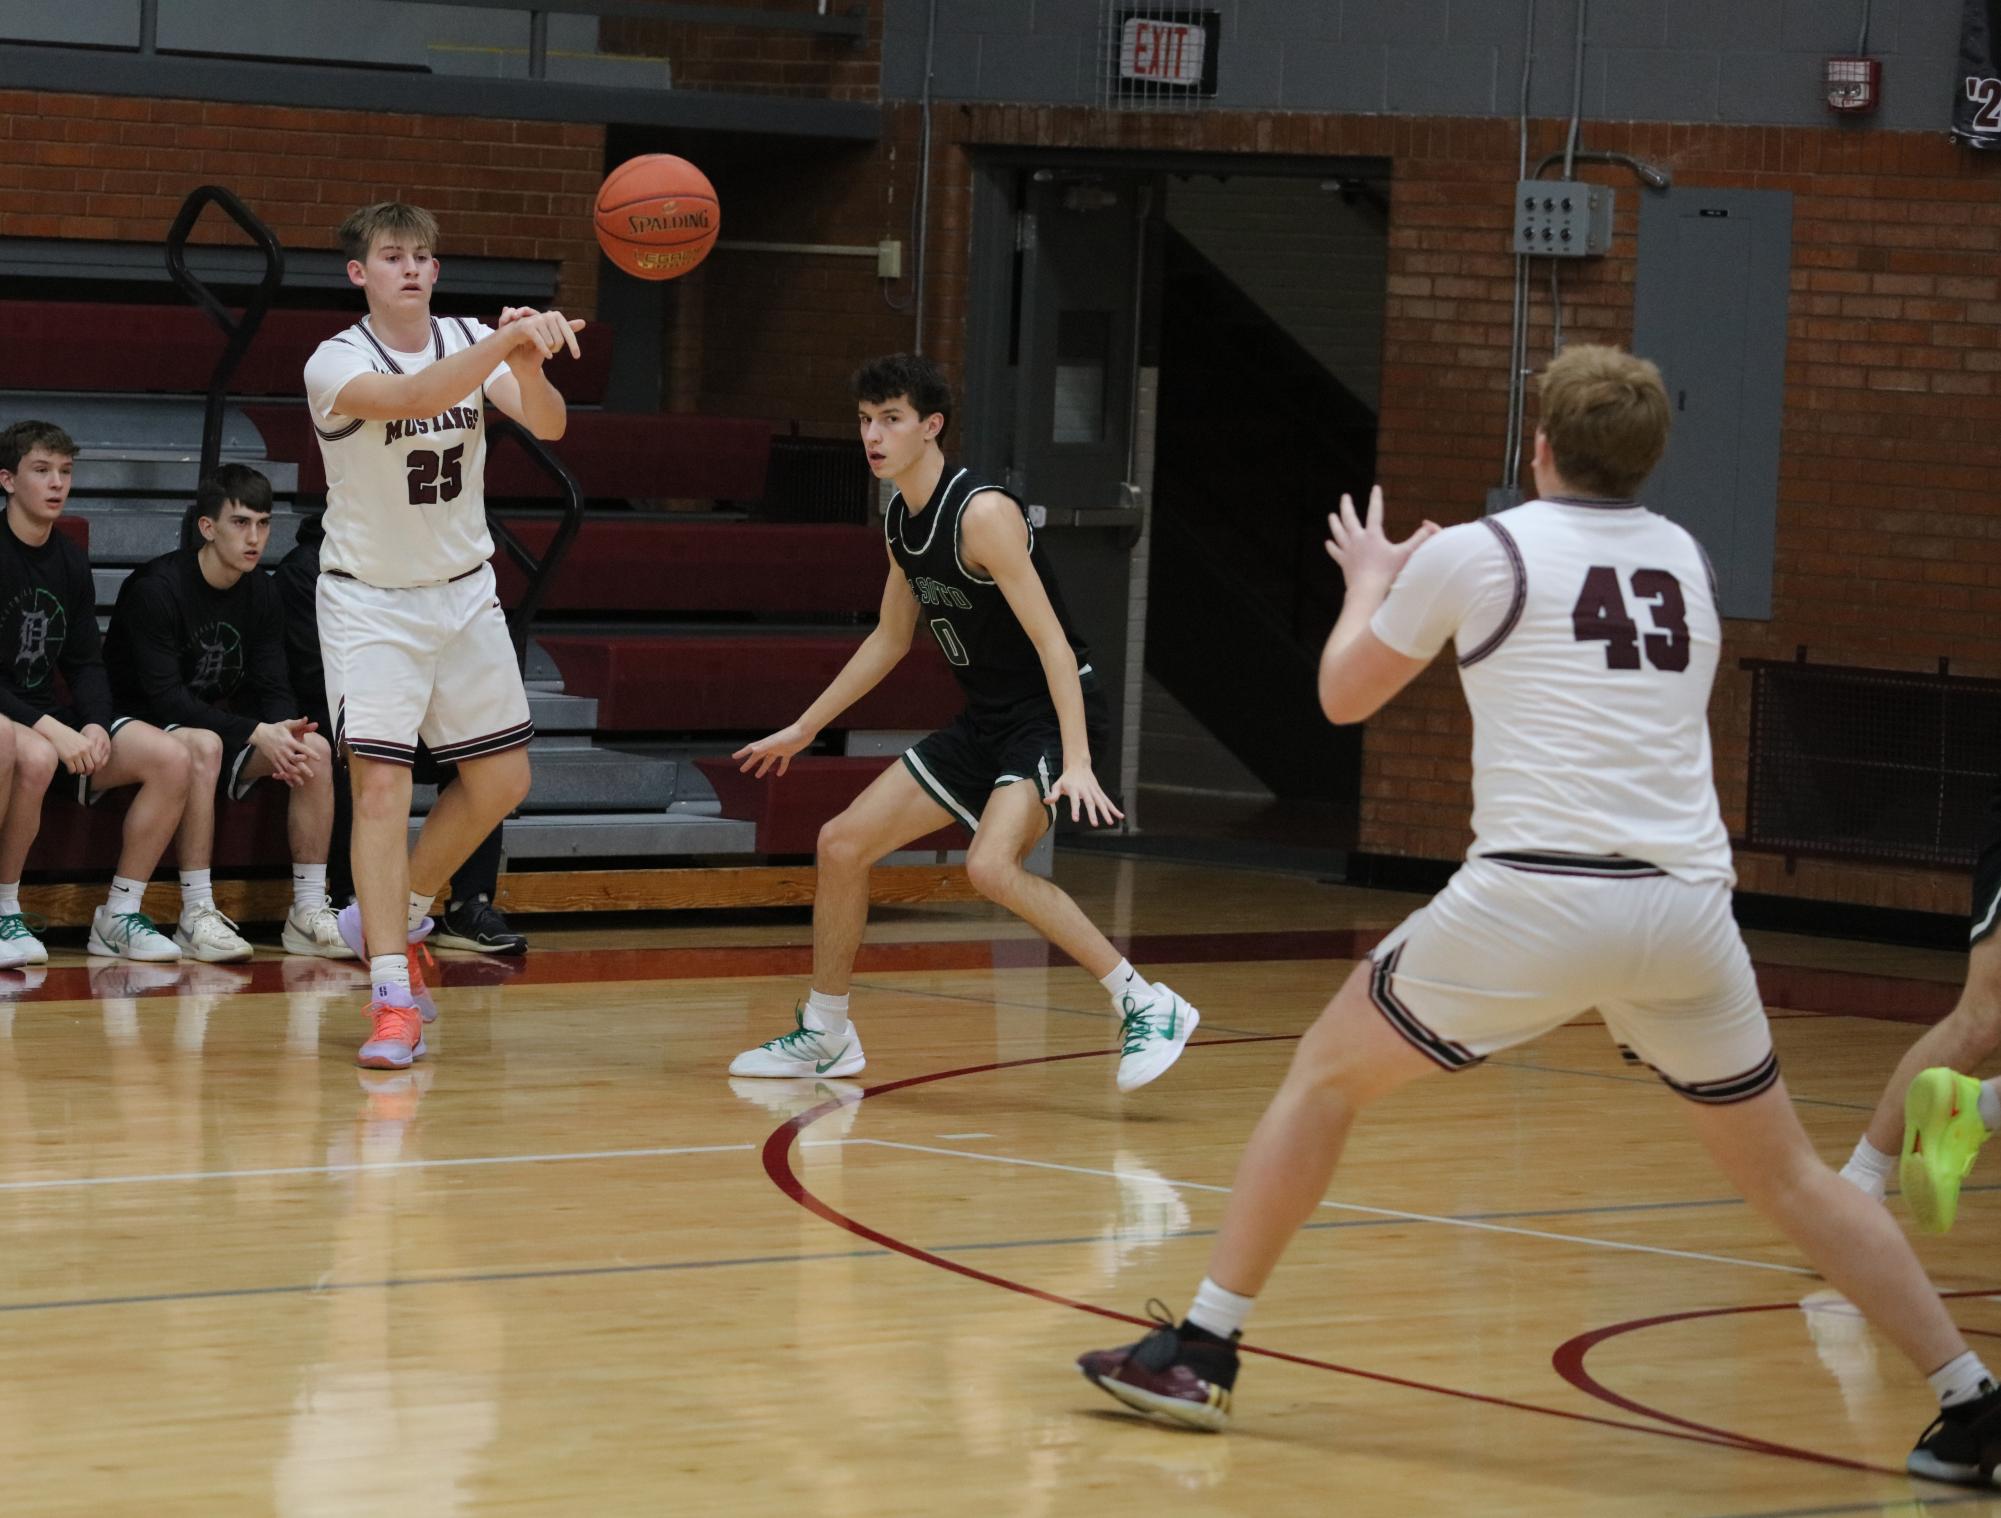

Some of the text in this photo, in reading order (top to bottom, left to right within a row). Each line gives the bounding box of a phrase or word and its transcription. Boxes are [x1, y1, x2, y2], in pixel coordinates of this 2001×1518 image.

[1134, 23, 1189, 79] EXIT
[628, 209, 709, 233] SPALDING
[406, 442, 464, 505] 25
[930, 617, 970, 667] 0
[1571, 566, 1690, 673] 43
